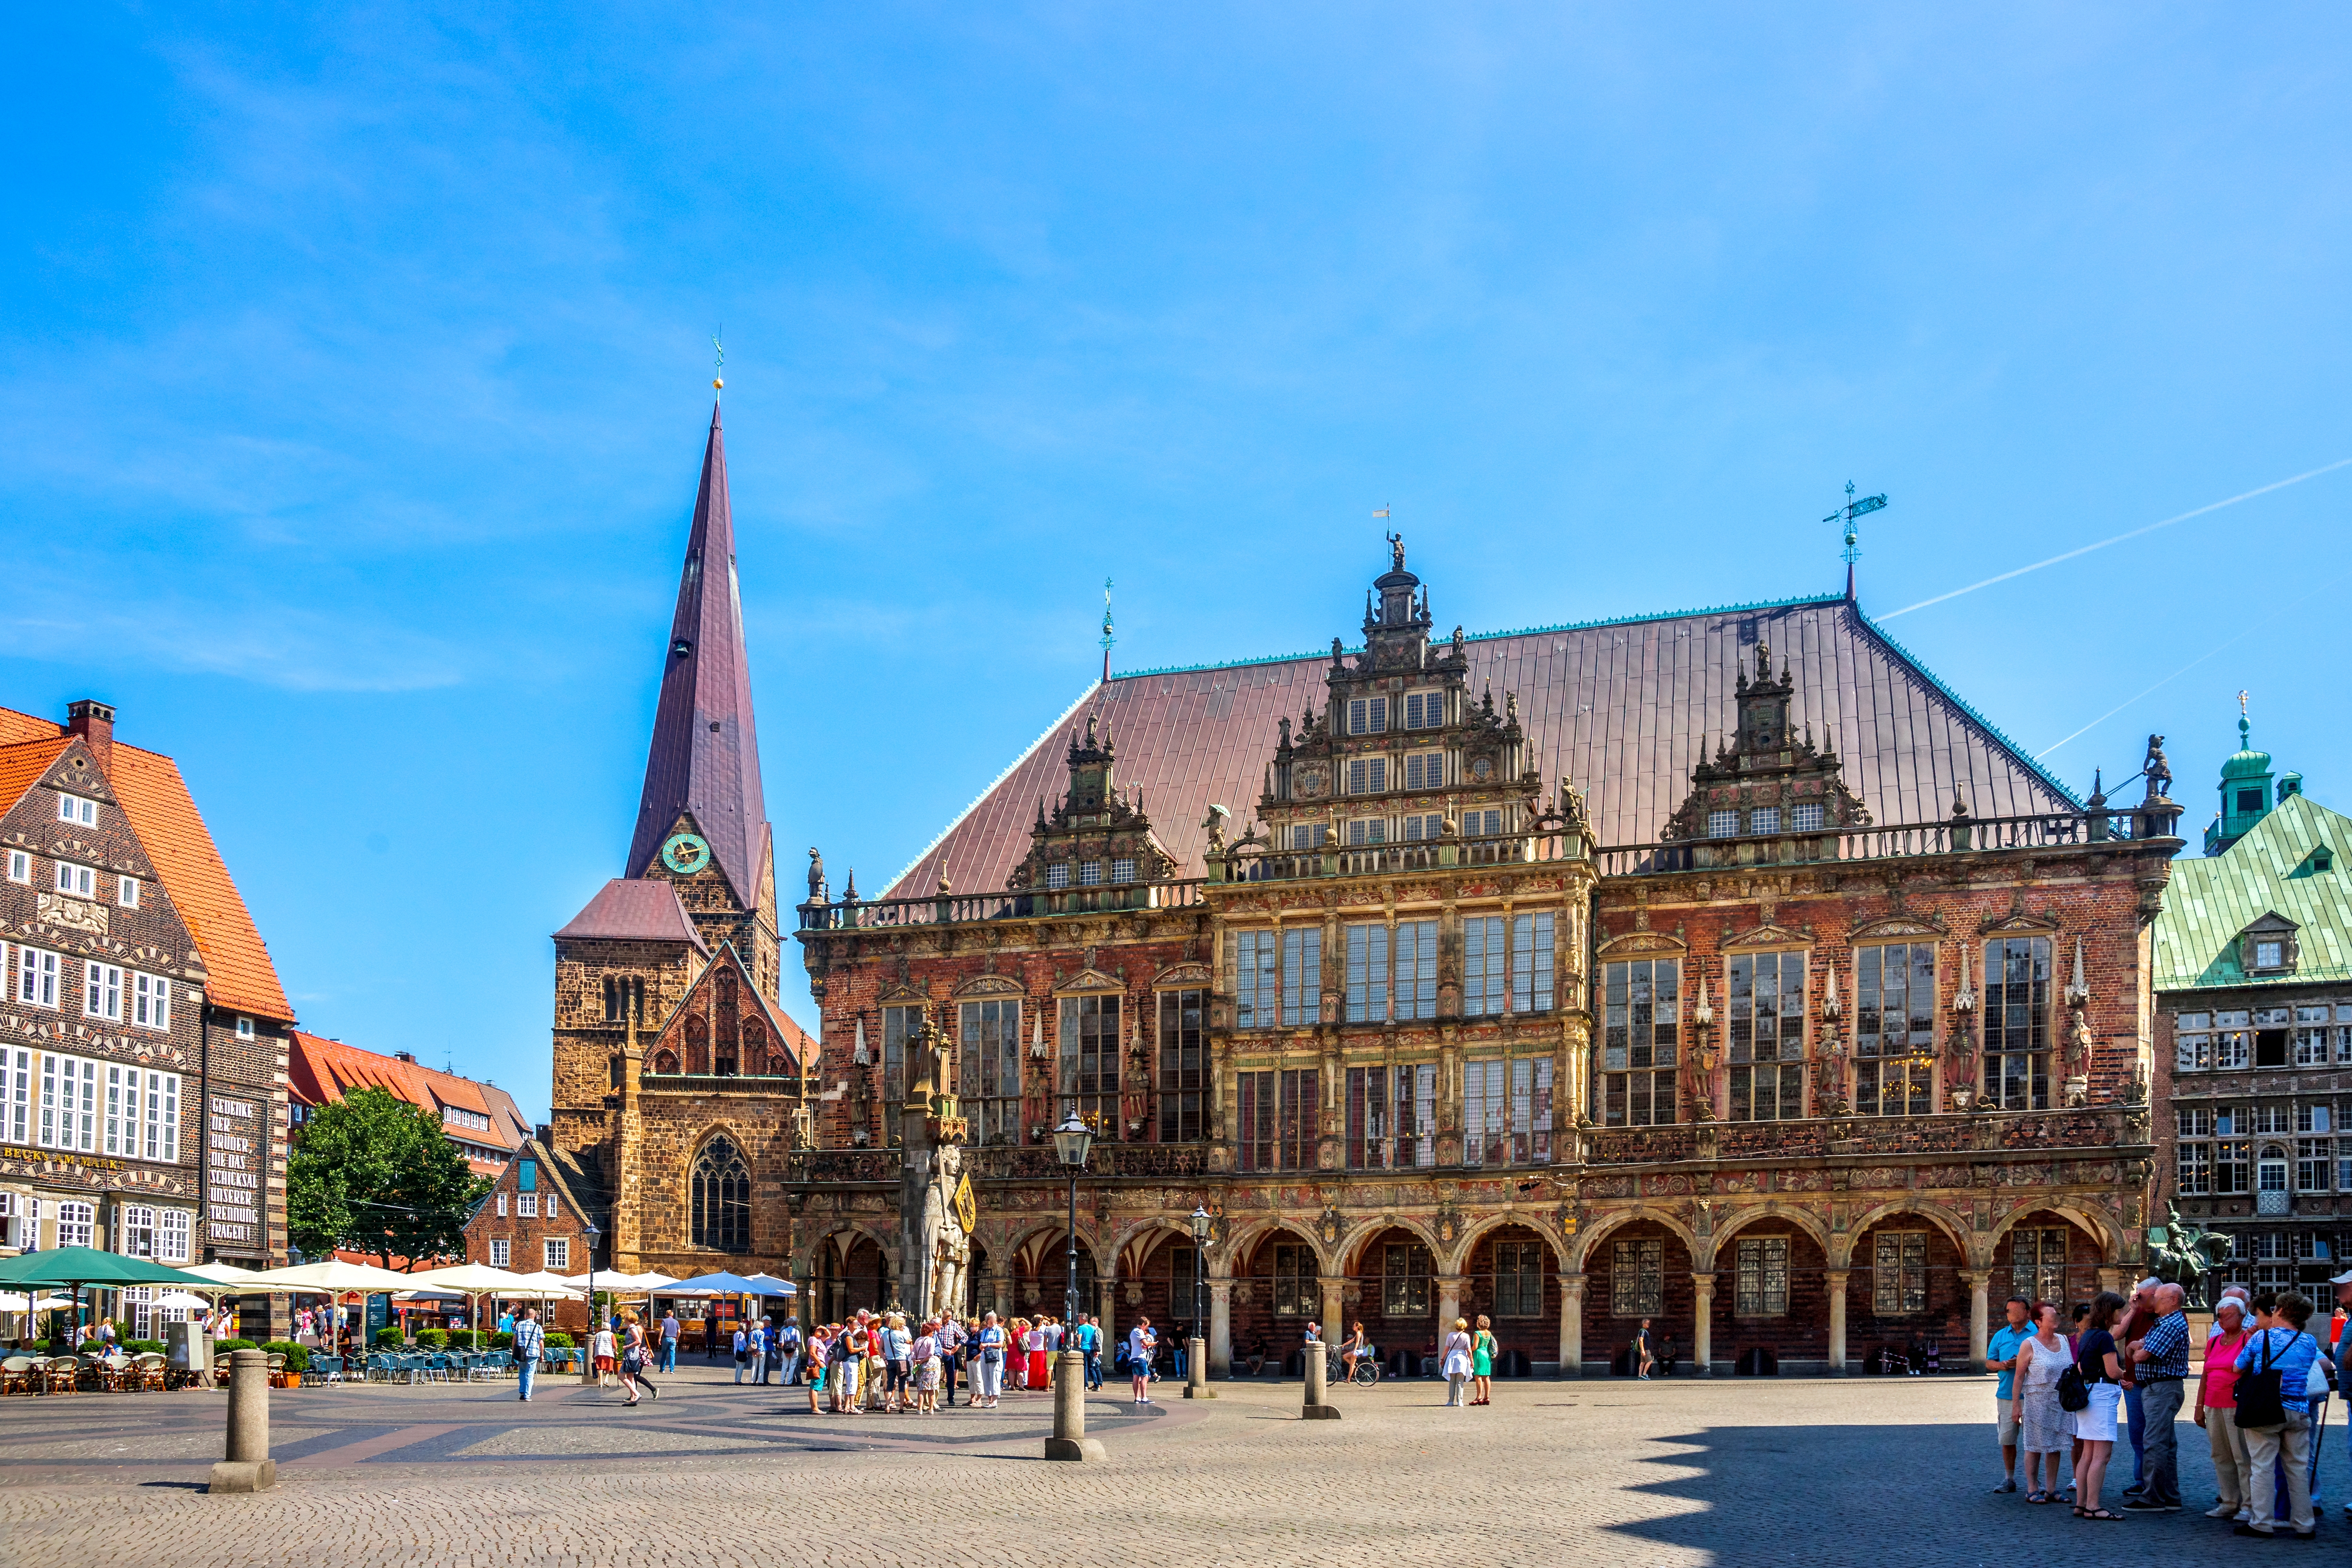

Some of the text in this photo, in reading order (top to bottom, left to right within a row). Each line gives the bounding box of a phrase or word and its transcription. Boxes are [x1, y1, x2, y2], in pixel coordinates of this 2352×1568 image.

[212, 1098, 253, 1118] GEDENKE
[211, 1116, 230, 1132] DER
[211, 1133, 252, 1154] BRÜDER,
[54, 1154, 75, 1164] AM
[81, 1156, 126, 1169] MARKT
[211, 1152, 246, 1169] DIE DAS
[211, 1169, 258, 1188] SCHICKSAL
[211, 1187, 252, 1205] UNSERER
[211, 1205, 258, 1223] TRENNUNG
